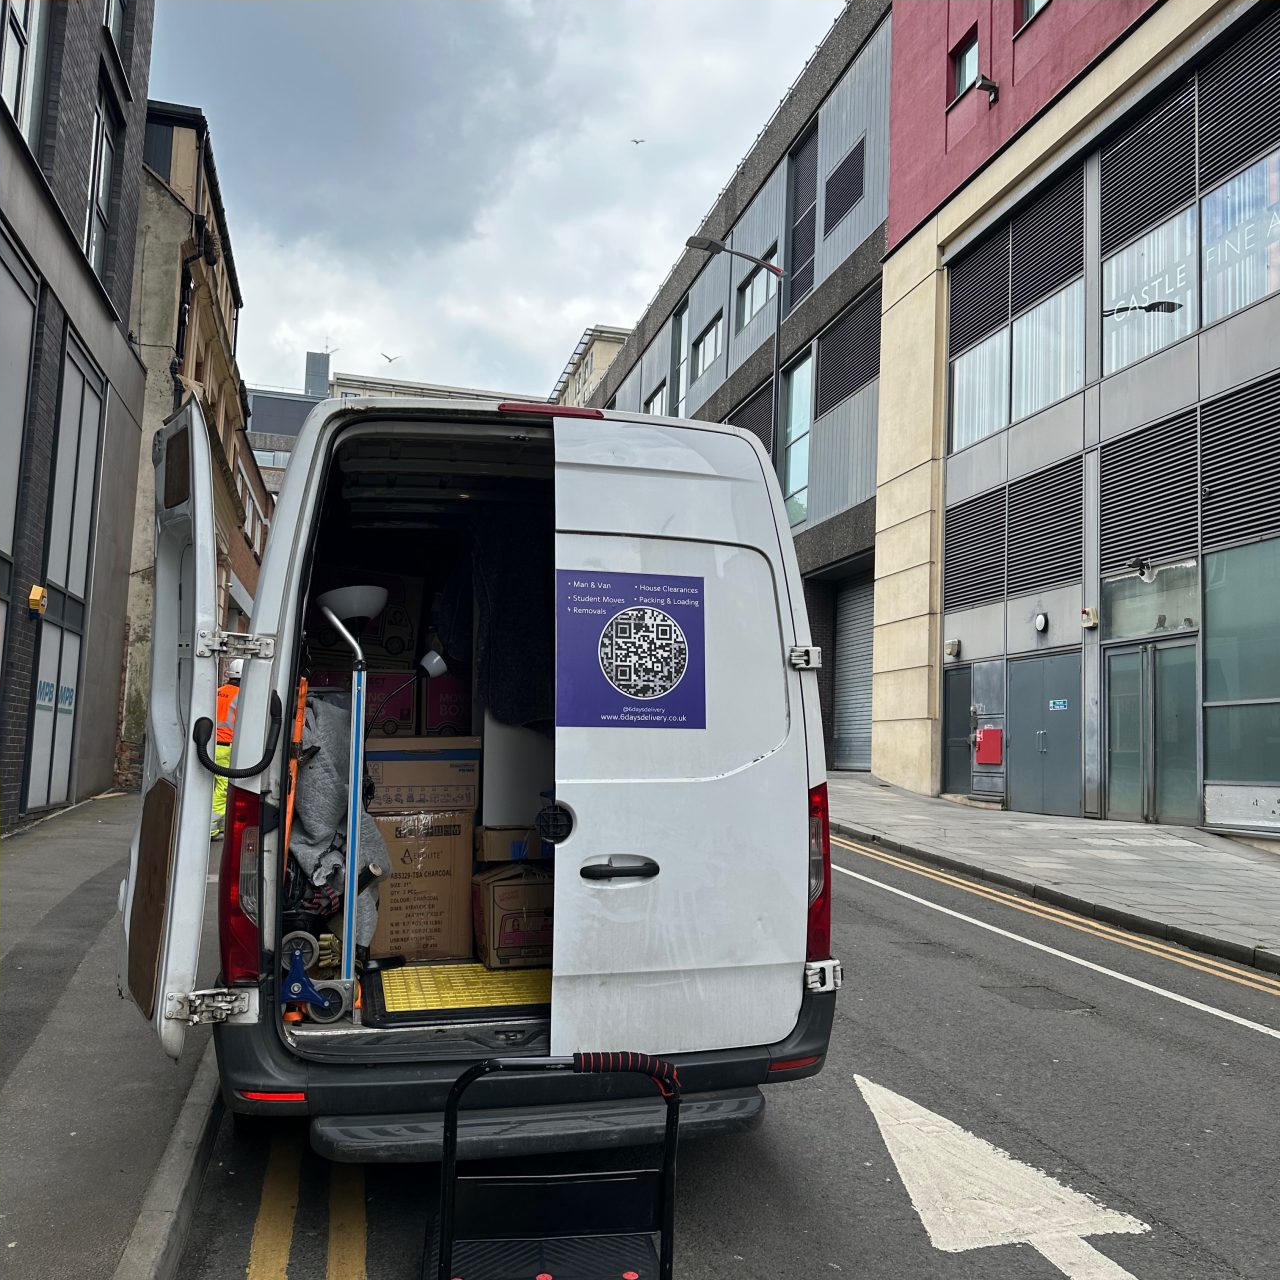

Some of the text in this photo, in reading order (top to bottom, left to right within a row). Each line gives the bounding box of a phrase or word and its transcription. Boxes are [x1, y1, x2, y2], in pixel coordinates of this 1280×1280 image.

[1113, 263, 1186, 322] CASTLE
[1206, 224, 1256, 272] FINE
[573, 595, 601, 603] Student
[640, 596, 665, 605] Packing
[674, 599, 700, 608] Loading
[37, 680, 54, 702] MPB
[59, 686, 74, 705] MPB
[600, 714, 686, 722] www.6daysdelivery.co.uk
